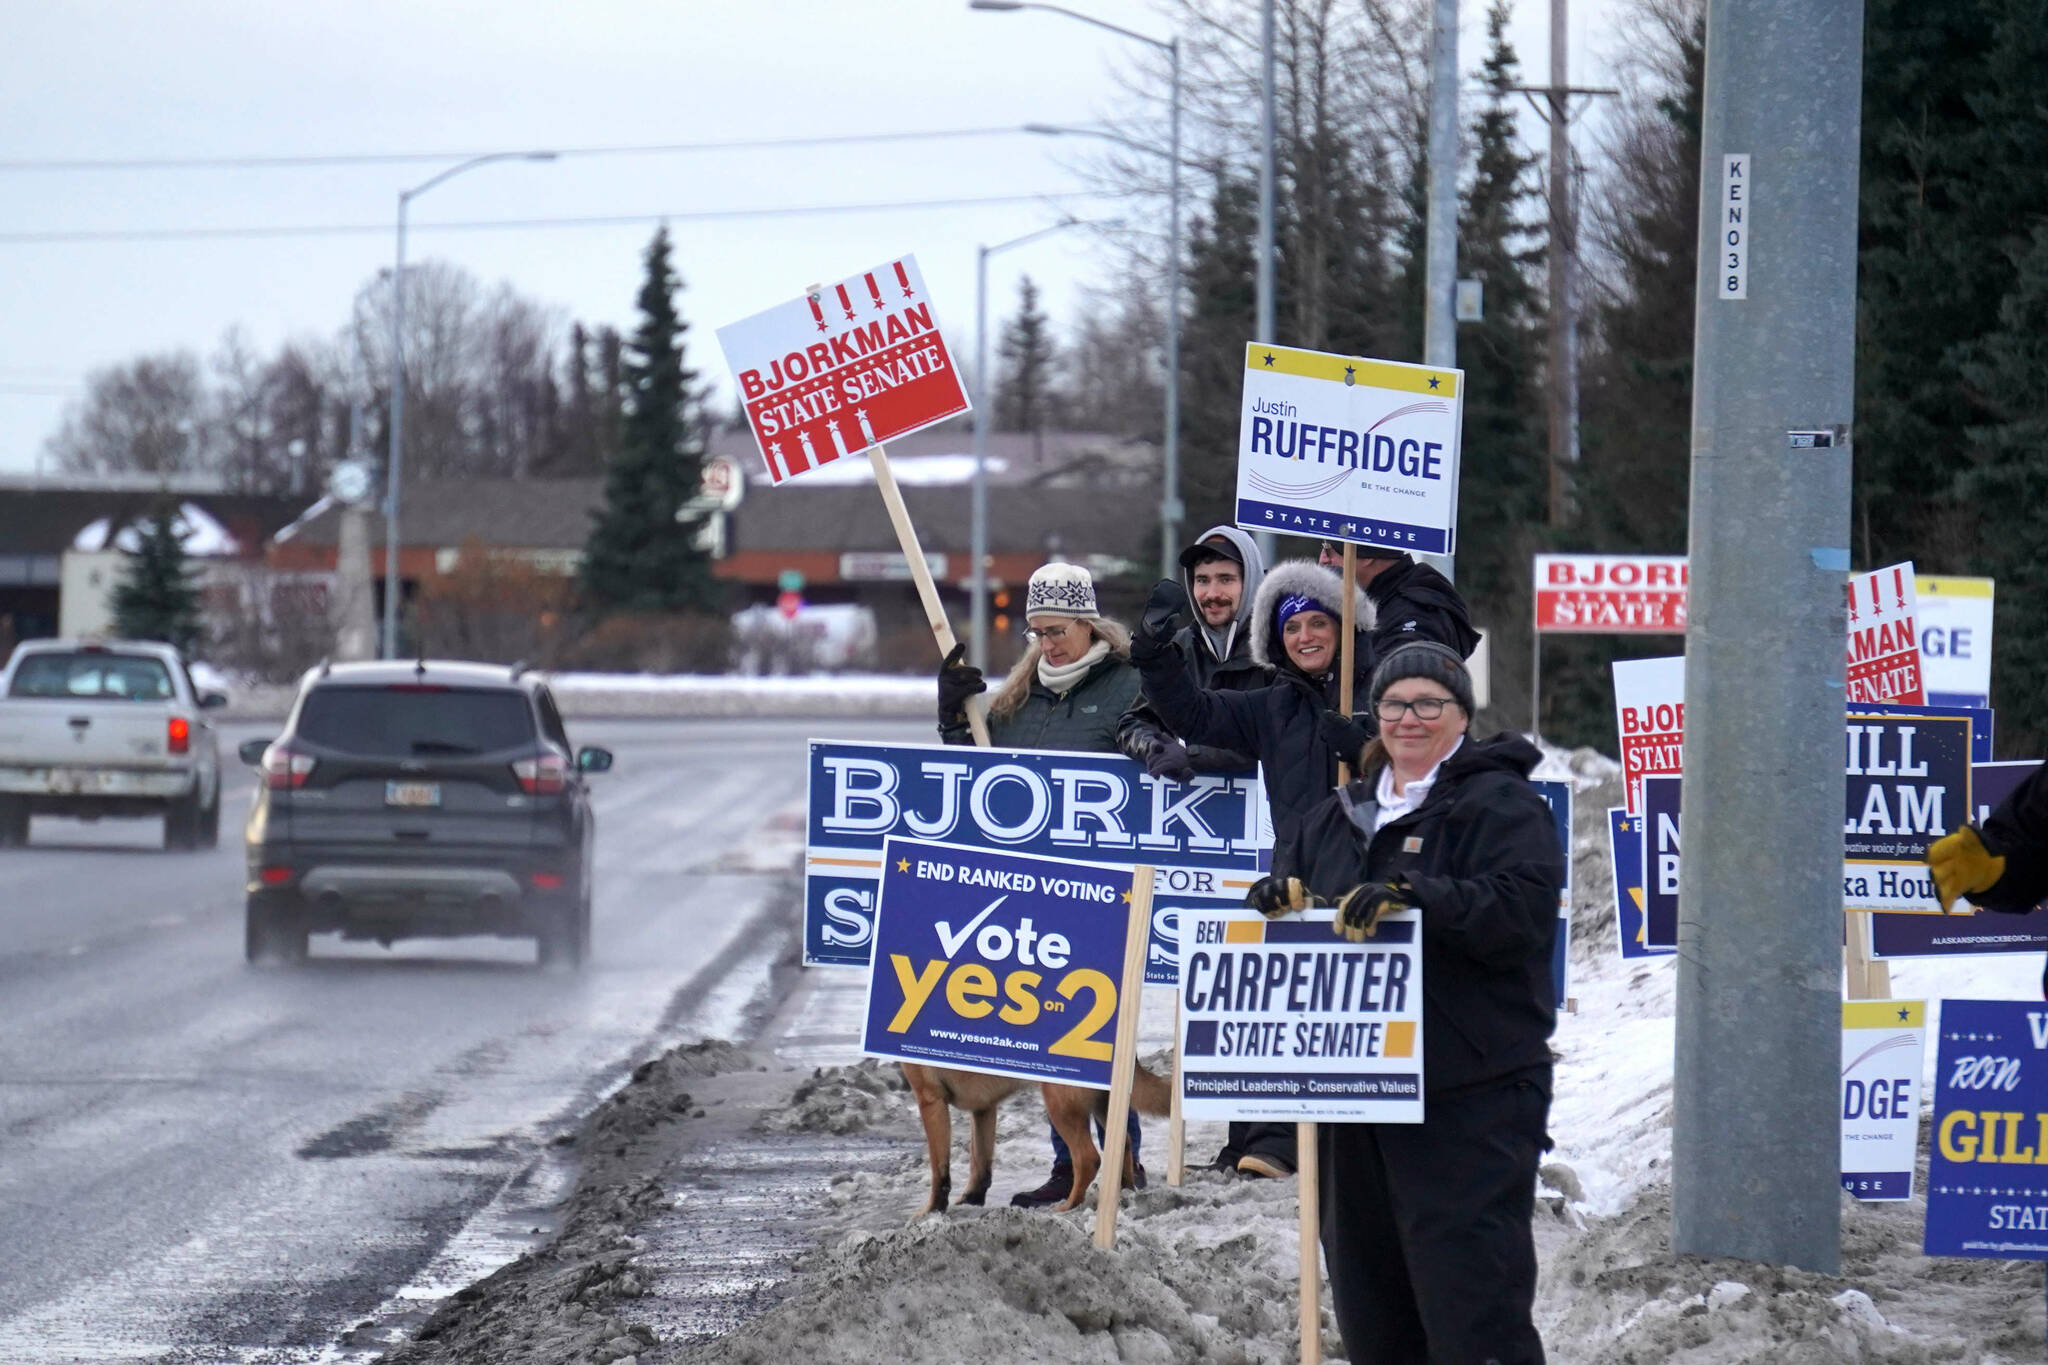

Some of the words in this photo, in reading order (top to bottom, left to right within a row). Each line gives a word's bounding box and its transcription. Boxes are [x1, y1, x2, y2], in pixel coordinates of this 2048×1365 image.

[738, 302, 934, 401] BJORKMAN
[759, 385, 842, 437] STATE
[842, 345, 945, 404] SENATE
[1252, 397, 1297, 418] Justin
[1251, 416, 1443, 481] RUFFRIDGE
[1361, 482, 1372, 490] BE
[1375, 484, 1391, 492] THE
[1393, 487, 1427, 498] CHANGE
[1265, 510, 1331, 529] STATE
[1346, 523, 1416, 542] HOUSE
[1555, 601, 1664, 625] STATE
[1844, 784, 1946, 836] AM
[1895, 842, 1910, 856] for
[1910, 842, 1925, 854] the
[916, 860, 954, 882] END
[958, 866, 1036, 892] RANKED
[1040, 877, 1116, 904] VOTING
[1154, 869, 1216, 893] FOR
[1196, 920, 1226, 944] BEN
[1146, 971, 1165, 980] State
[1185, 951, 1412, 1012] CARPENTER
[887, 954, 1041, 1034] yes
[1044, 1000, 1065, 1012] on
[1048, 968, 1118, 1063] 2
[930, 1028, 1039, 1051] www.yeson2ak.com
[1220, 1021, 1288, 1057] STATE
[1293, 1022, 1382, 1058] SENATE
[1186, 1078, 1239, 1098] Principled
[1241, 1079, 1300, 1099] Leadership
[1308, 1080, 1379, 1093] Conservative
[1380, 1081, 1416, 1094] Values
[1950, 1055, 2022, 1092] RON
[1843, 1078, 1911, 1120] DGE
[1862, 1133, 1894, 1141] CHANGE
